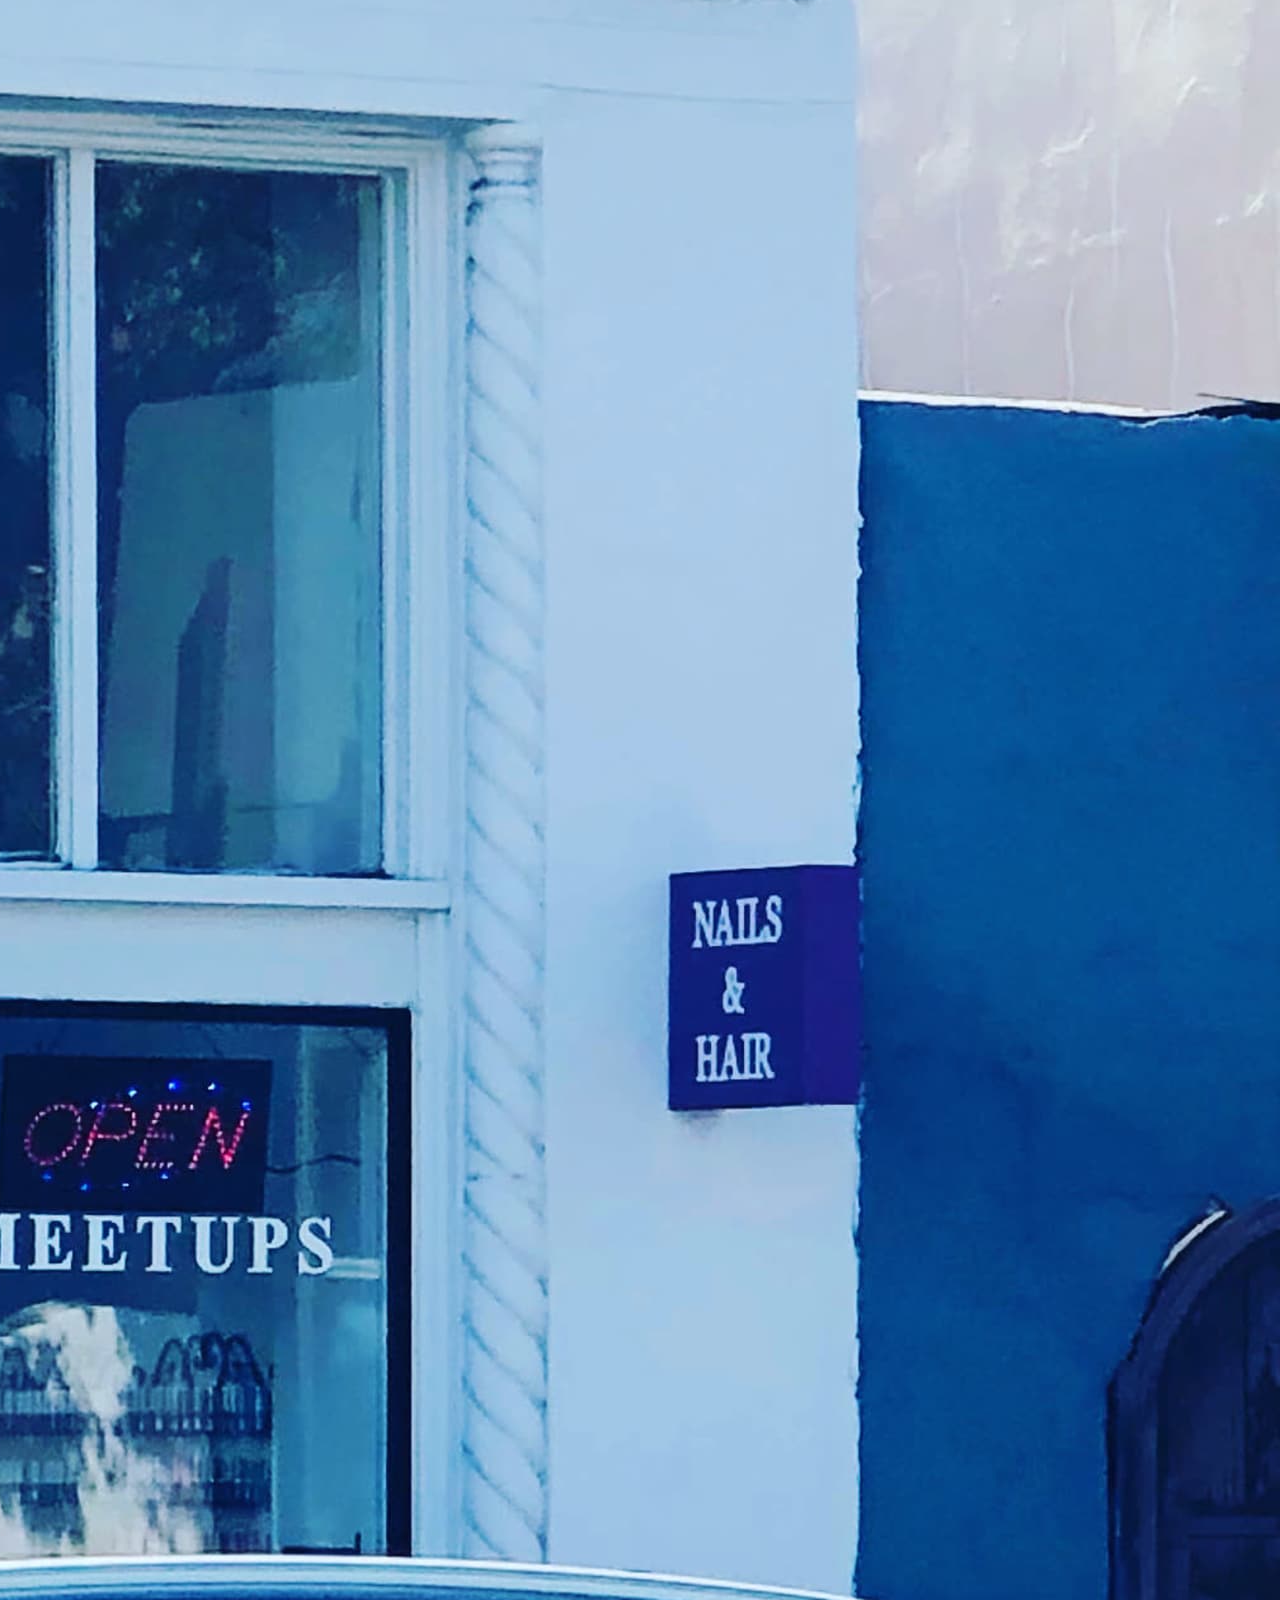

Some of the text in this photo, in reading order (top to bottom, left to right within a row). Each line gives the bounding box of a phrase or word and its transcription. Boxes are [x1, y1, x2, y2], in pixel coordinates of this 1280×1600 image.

[691, 894, 783, 949] NAILS
[721, 966, 746, 1015] &
[694, 1032, 776, 1083] HAIR
[21, 1101, 251, 1172] OPEN
